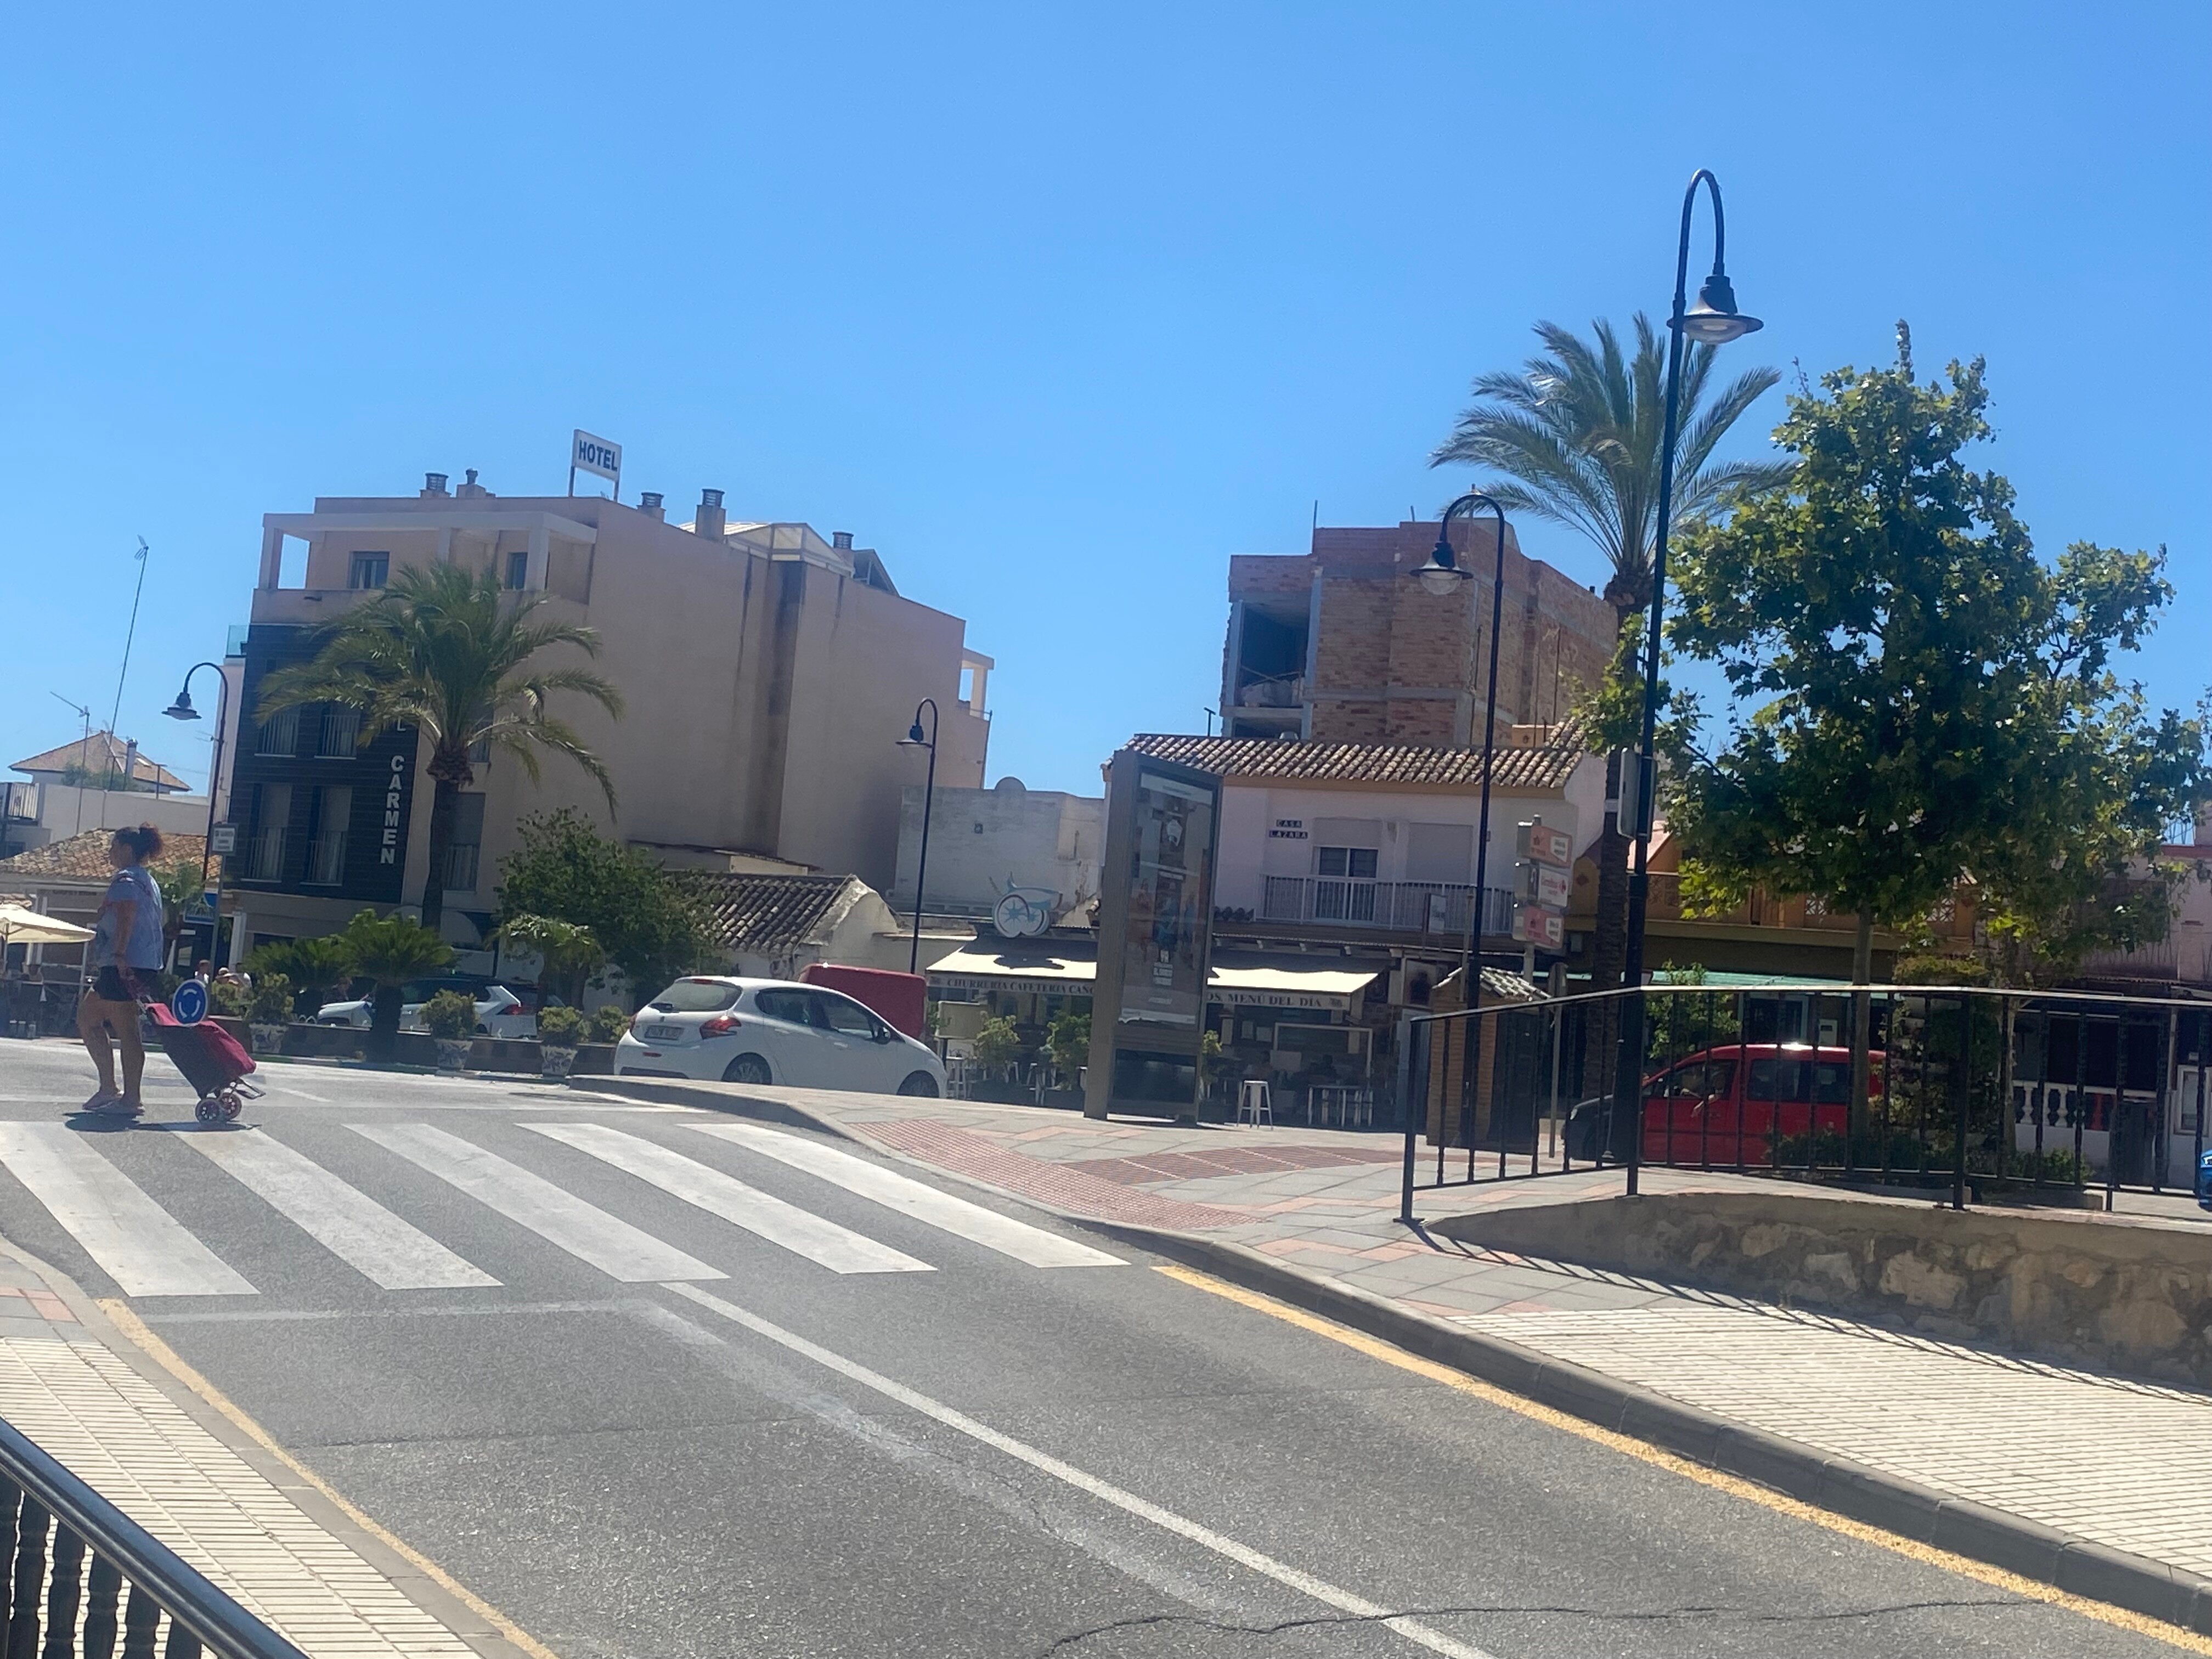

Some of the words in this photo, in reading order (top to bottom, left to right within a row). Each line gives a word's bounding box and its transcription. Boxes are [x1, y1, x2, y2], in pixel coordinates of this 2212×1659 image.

[578, 439, 618, 472] HOTEL
[380, 755, 405, 865] CARMEN
[1277, 820, 1301, 828] CASA
[1269, 996, 1294, 1006] DEL
